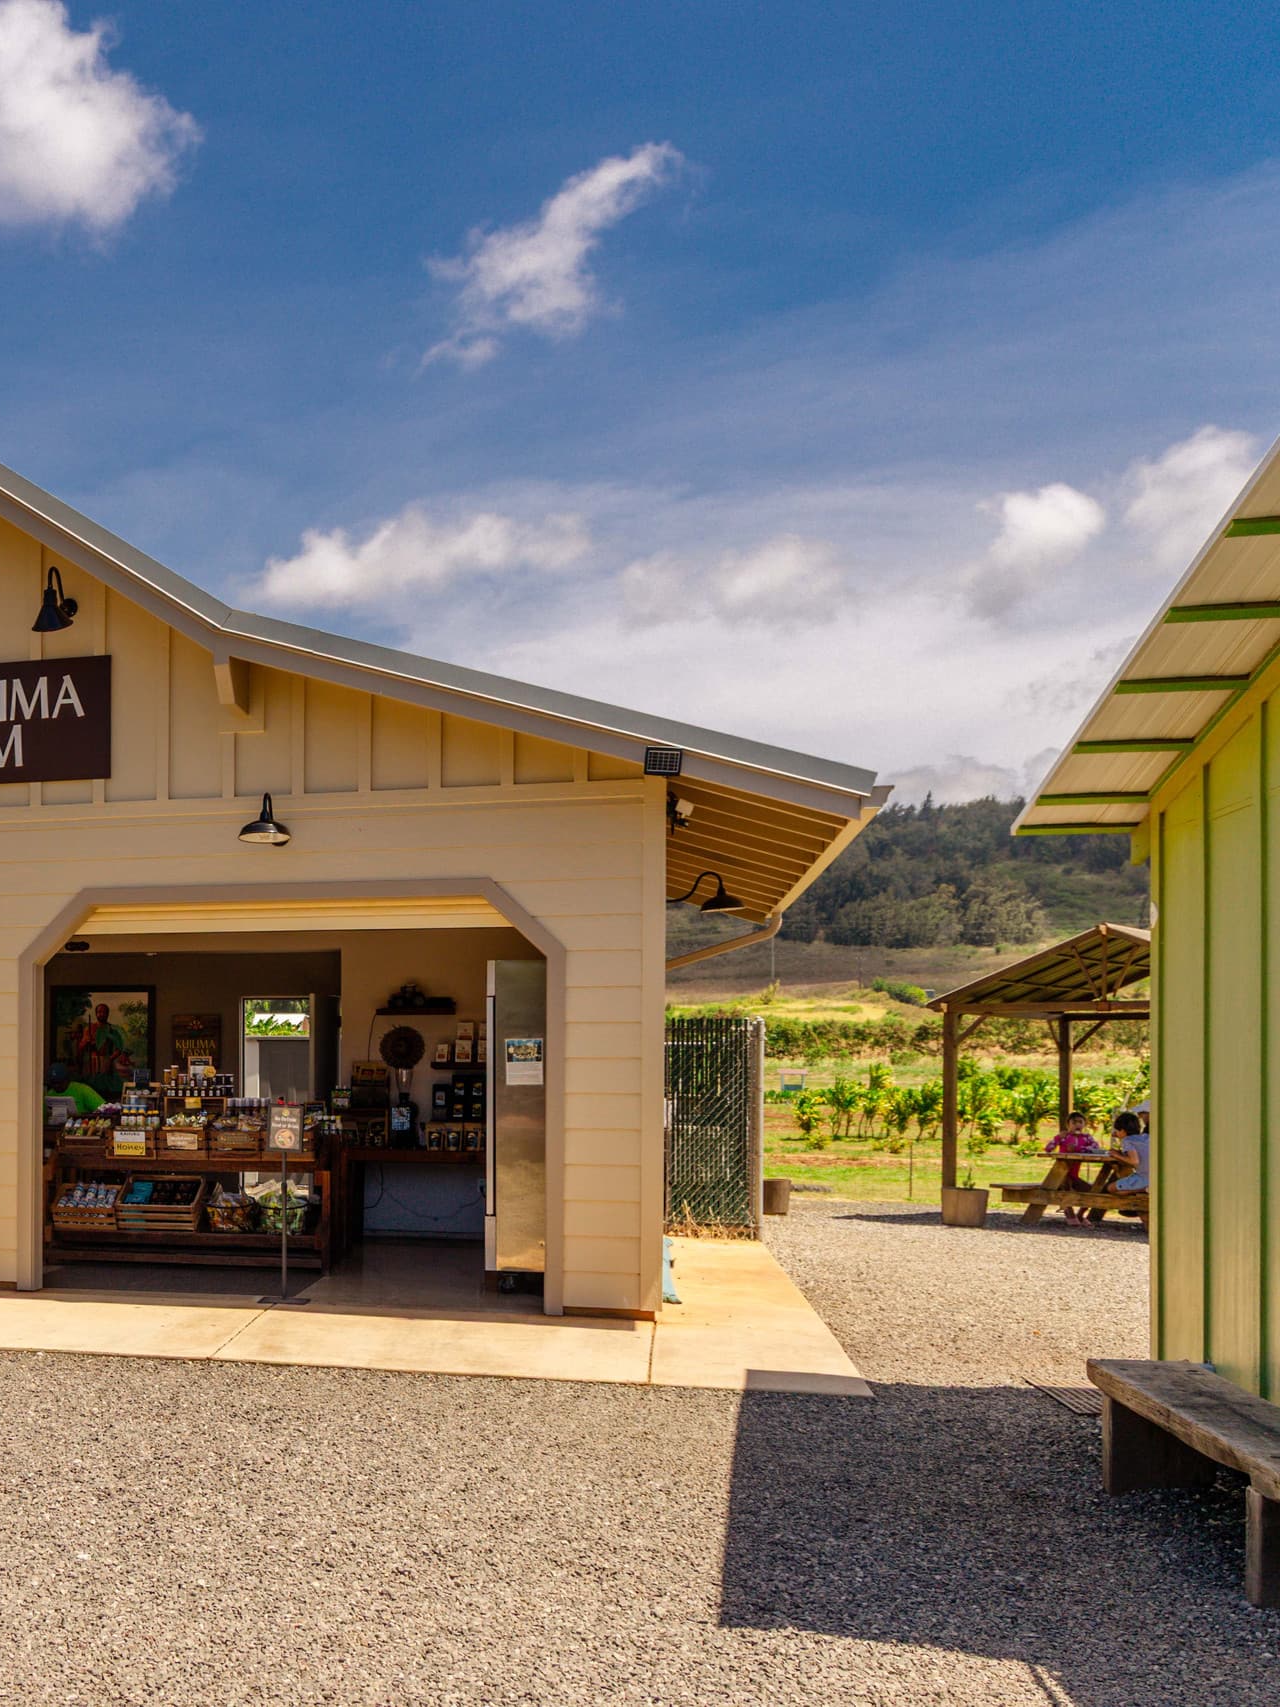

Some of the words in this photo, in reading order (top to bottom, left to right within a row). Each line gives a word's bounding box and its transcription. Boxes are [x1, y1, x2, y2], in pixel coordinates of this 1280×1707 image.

[175, 1039, 216, 1049] KUILIMA
[182, 1049, 210, 1058] FARM
[116, 1143, 145, 1154] Honey
